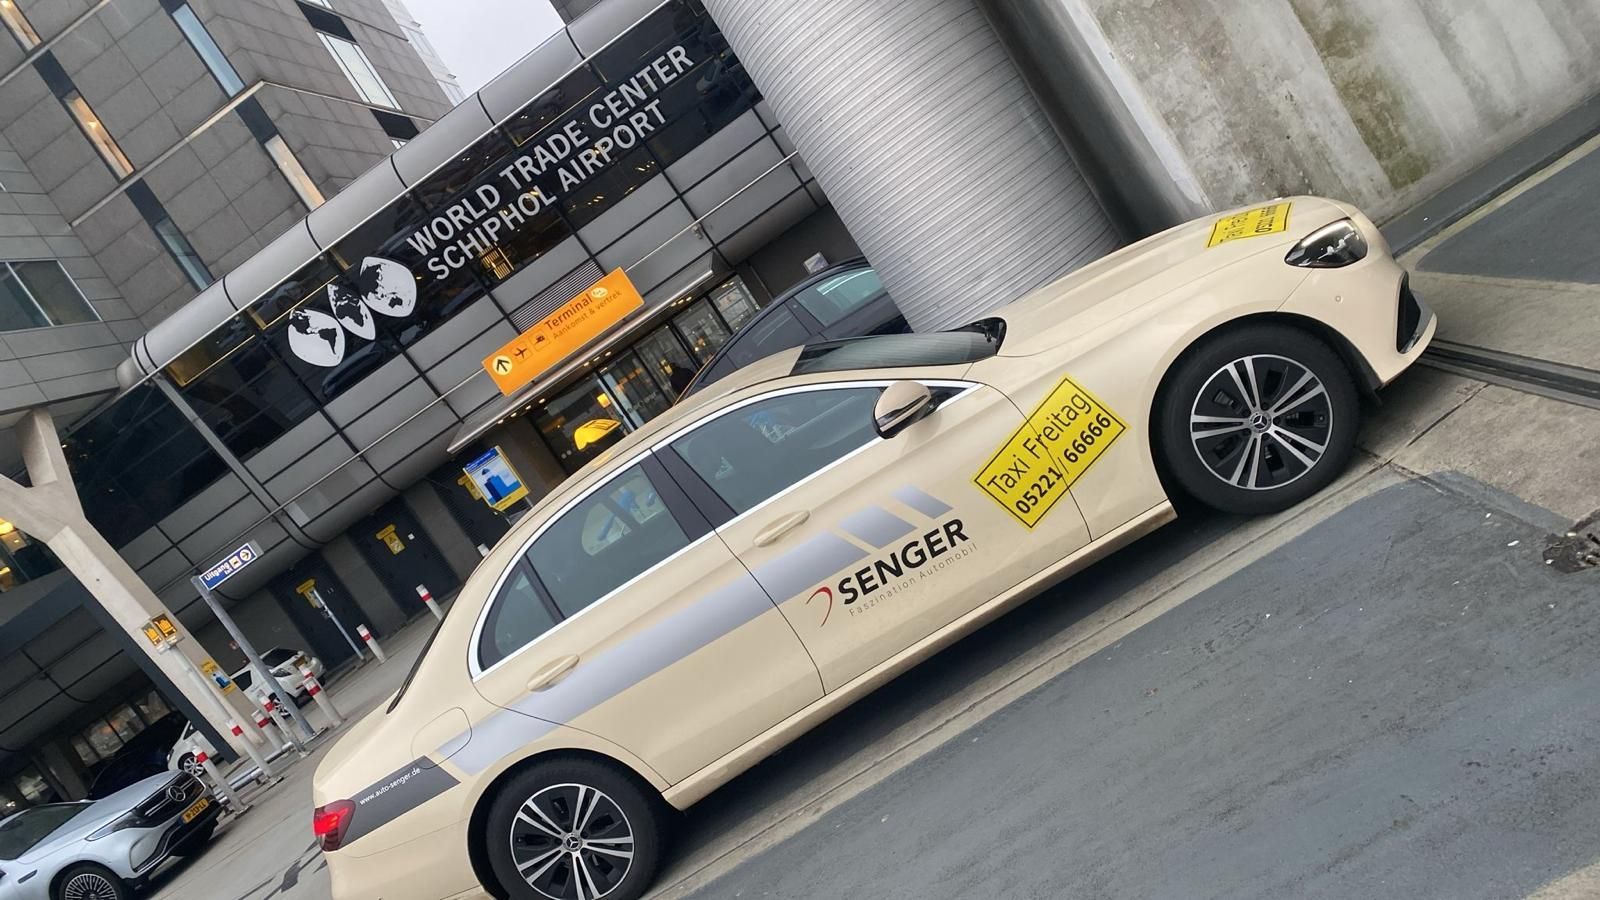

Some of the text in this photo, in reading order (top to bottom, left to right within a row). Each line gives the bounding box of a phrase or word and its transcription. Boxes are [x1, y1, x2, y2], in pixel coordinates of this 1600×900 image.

[405, 45, 695, 258] WORLD TRADE CENTER
[427, 98, 667, 281] SCHIPHOL AIRPORT
[545, 293, 593, 330] Terminal
[553, 313, 588, 339] Aankomst
[596, 291, 621, 310] vertrek
[986, 393, 1092, 494] Taxi Freitag
[204, 562, 230, 581] Uitgang
[838, 518, 970, 605] SENGER
[848, 542, 978, 617] Faszination Automobil
[360, 767, 421, 805] www.auto-senger.de
